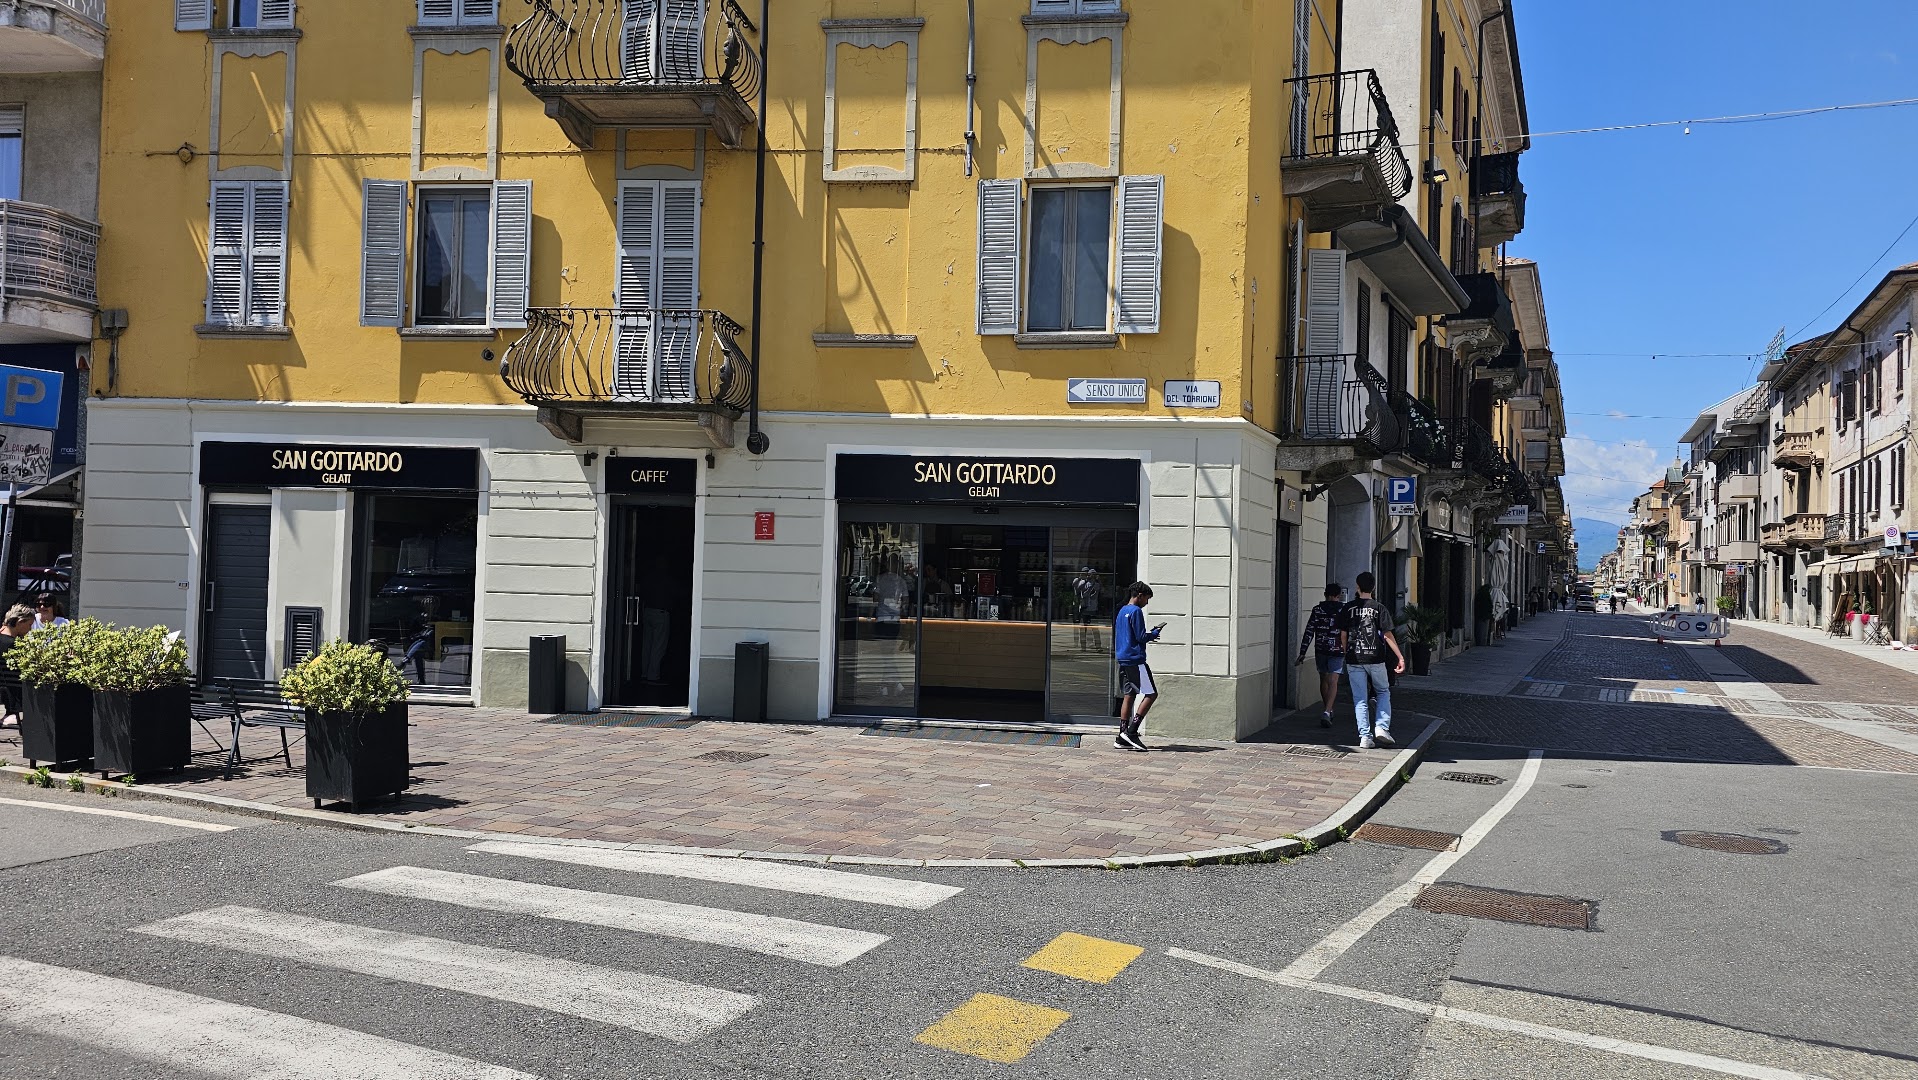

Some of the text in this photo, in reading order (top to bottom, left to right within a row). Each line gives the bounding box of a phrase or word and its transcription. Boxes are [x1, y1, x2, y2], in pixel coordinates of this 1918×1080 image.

[4, 374, 46, 417] P
[1086, 384, 1144, 397] SENSO UNICO
[1185, 385, 1198, 393] VIA
[1166, 394, 1217, 403] DEL TORRIONE
[271, 449, 403, 473] SAN GOTTARDO
[321, 473, 351, 484] GELATI
[631, 469, 669, 483] CAFFE'
[914, 461, 1056, 485] SAN GOTTARDO
[968, 486, 1000, 498] GELATI
[1393, 480, 1411, 501] P
[1348, 605, 1379, 619] Tupac
